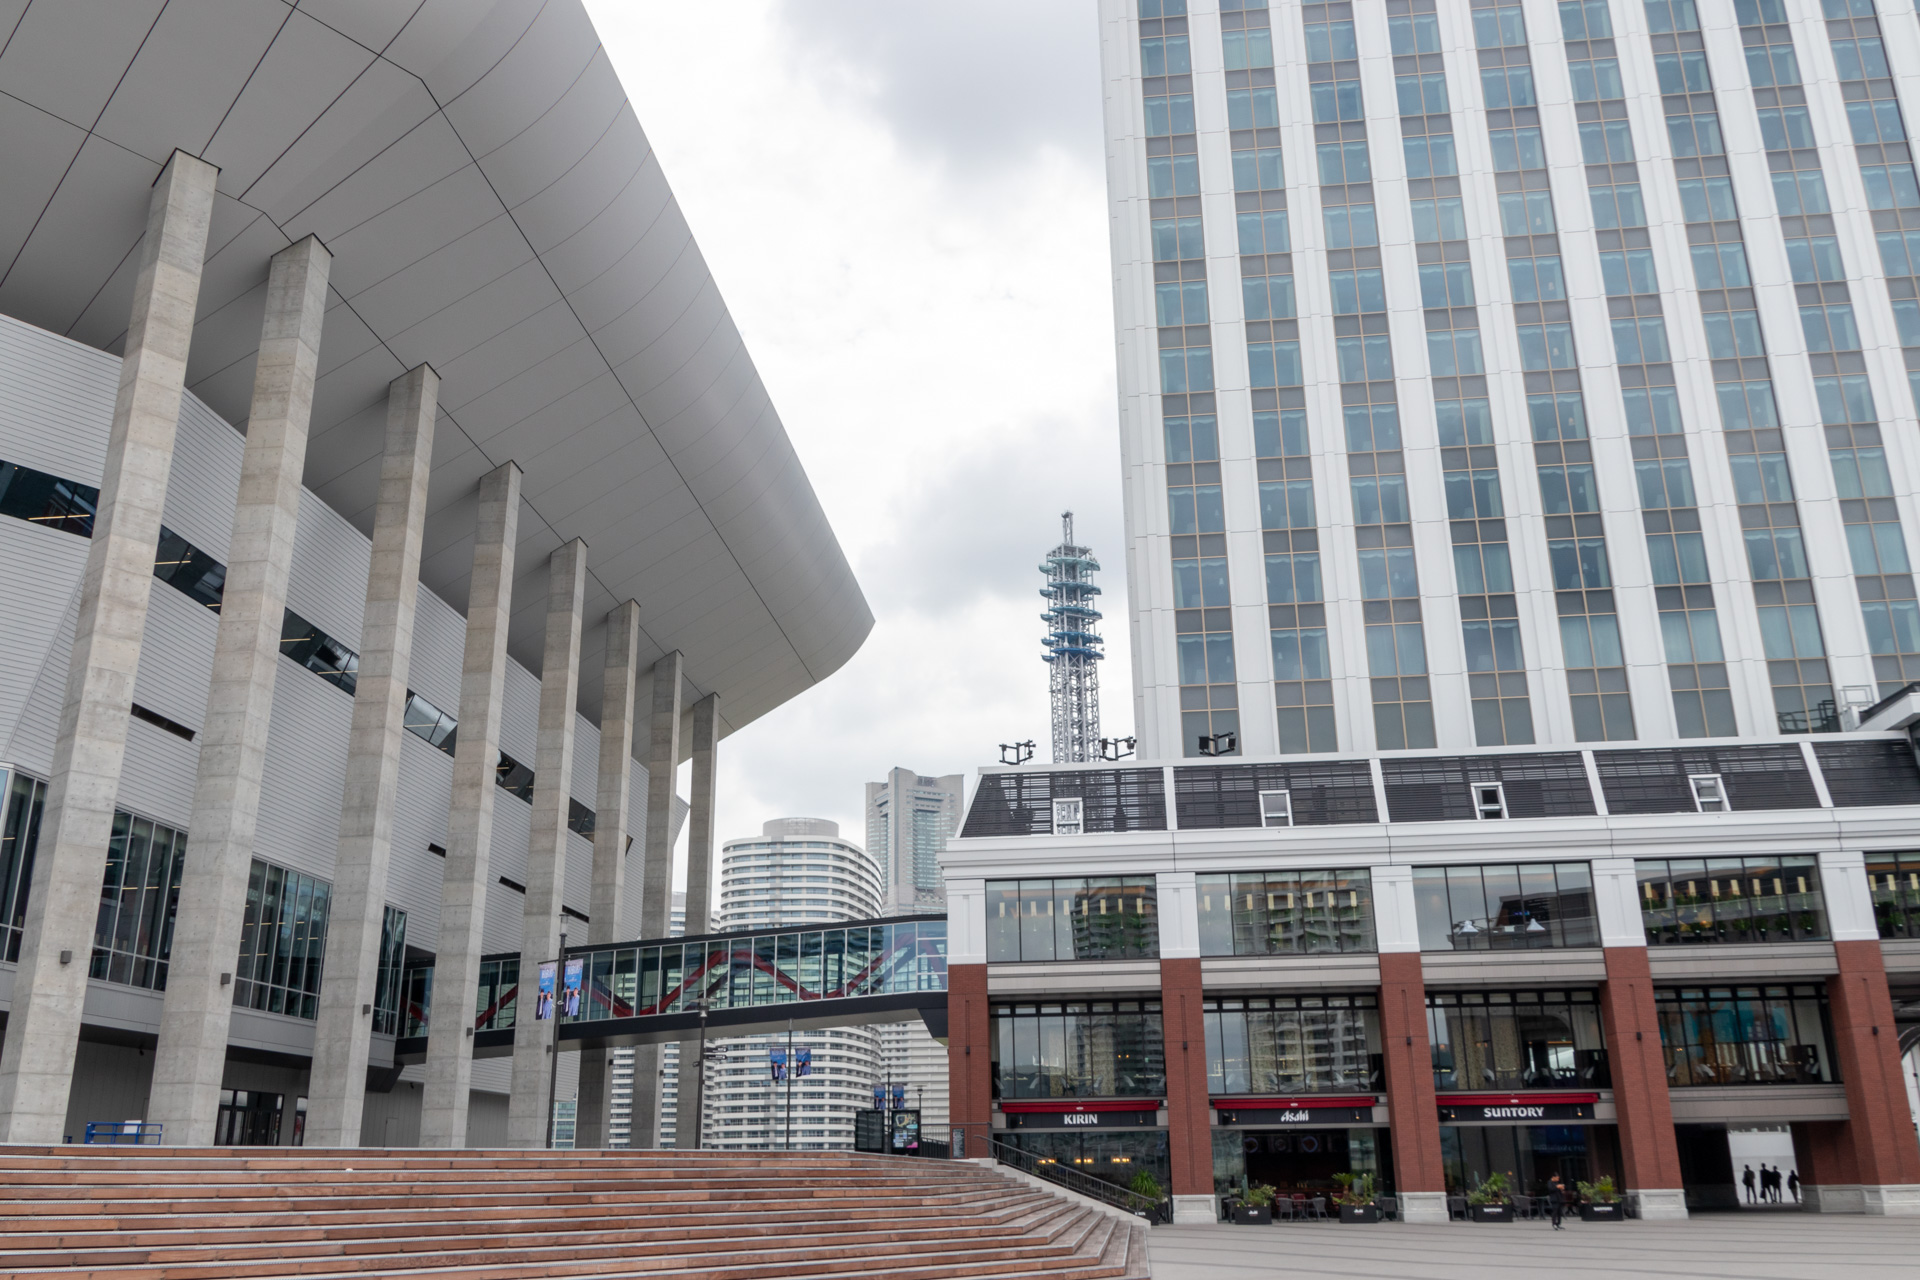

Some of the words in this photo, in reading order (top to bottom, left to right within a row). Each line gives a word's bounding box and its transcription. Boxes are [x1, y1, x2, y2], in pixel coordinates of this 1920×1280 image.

[1280, 1110, 1309, 1122] Asahi
[1483, 1106, 1545, 1118] SUNTORY
[1064, 1114, 1098, 1125] KIRIN
